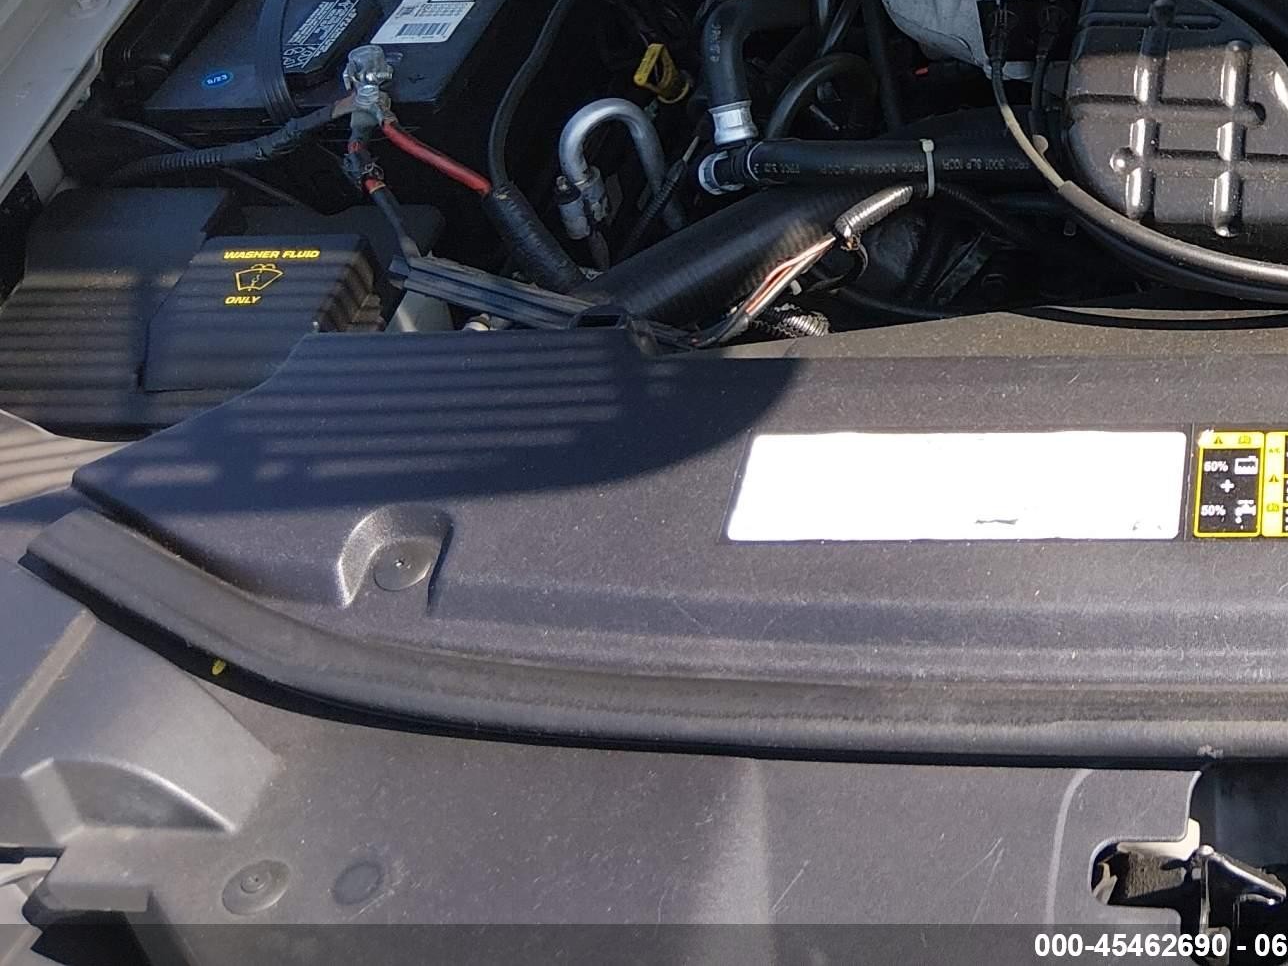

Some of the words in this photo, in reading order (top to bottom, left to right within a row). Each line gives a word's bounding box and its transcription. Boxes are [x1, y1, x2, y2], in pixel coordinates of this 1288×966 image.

[224, 250, 280, 259] WASHER
[282, 250, 320, 258] FLUID
[225, 296, 261, 304] ONLY
